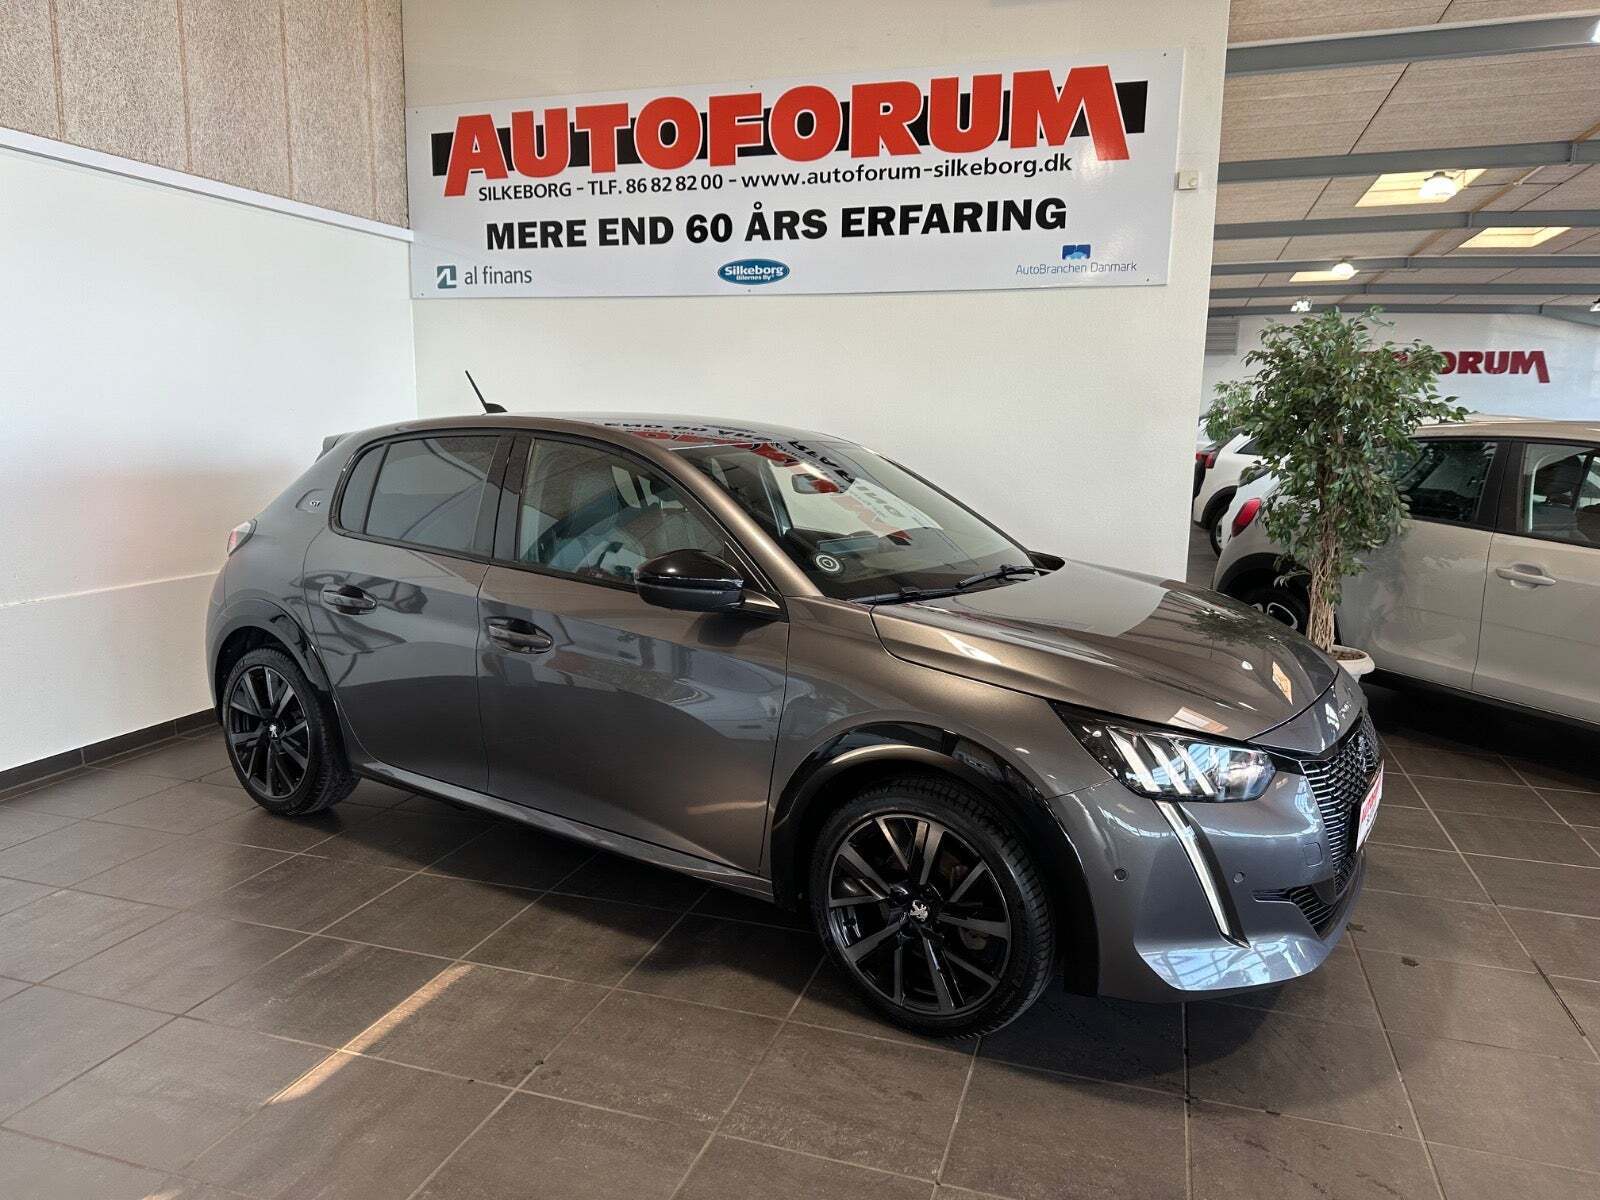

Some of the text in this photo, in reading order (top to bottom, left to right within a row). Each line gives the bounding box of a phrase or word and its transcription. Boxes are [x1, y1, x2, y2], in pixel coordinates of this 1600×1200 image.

[444, 64, 1130, 197] AUTOFORUM
[478, 182, 572, 201] SILKEBORG
[588, 180, 622, 196] TLF.
[741, 153, 1073, 188] www.autoforum-silkeborg.dk
[486, 198, 1067, 250] MERE END 60 ÅRS ERFARING
[464, 265, 532, 285] al finans
[724, 265, 784, 277] Silkeborg
[1016, 260, 1137, 275] AutoBranchen Danmark
